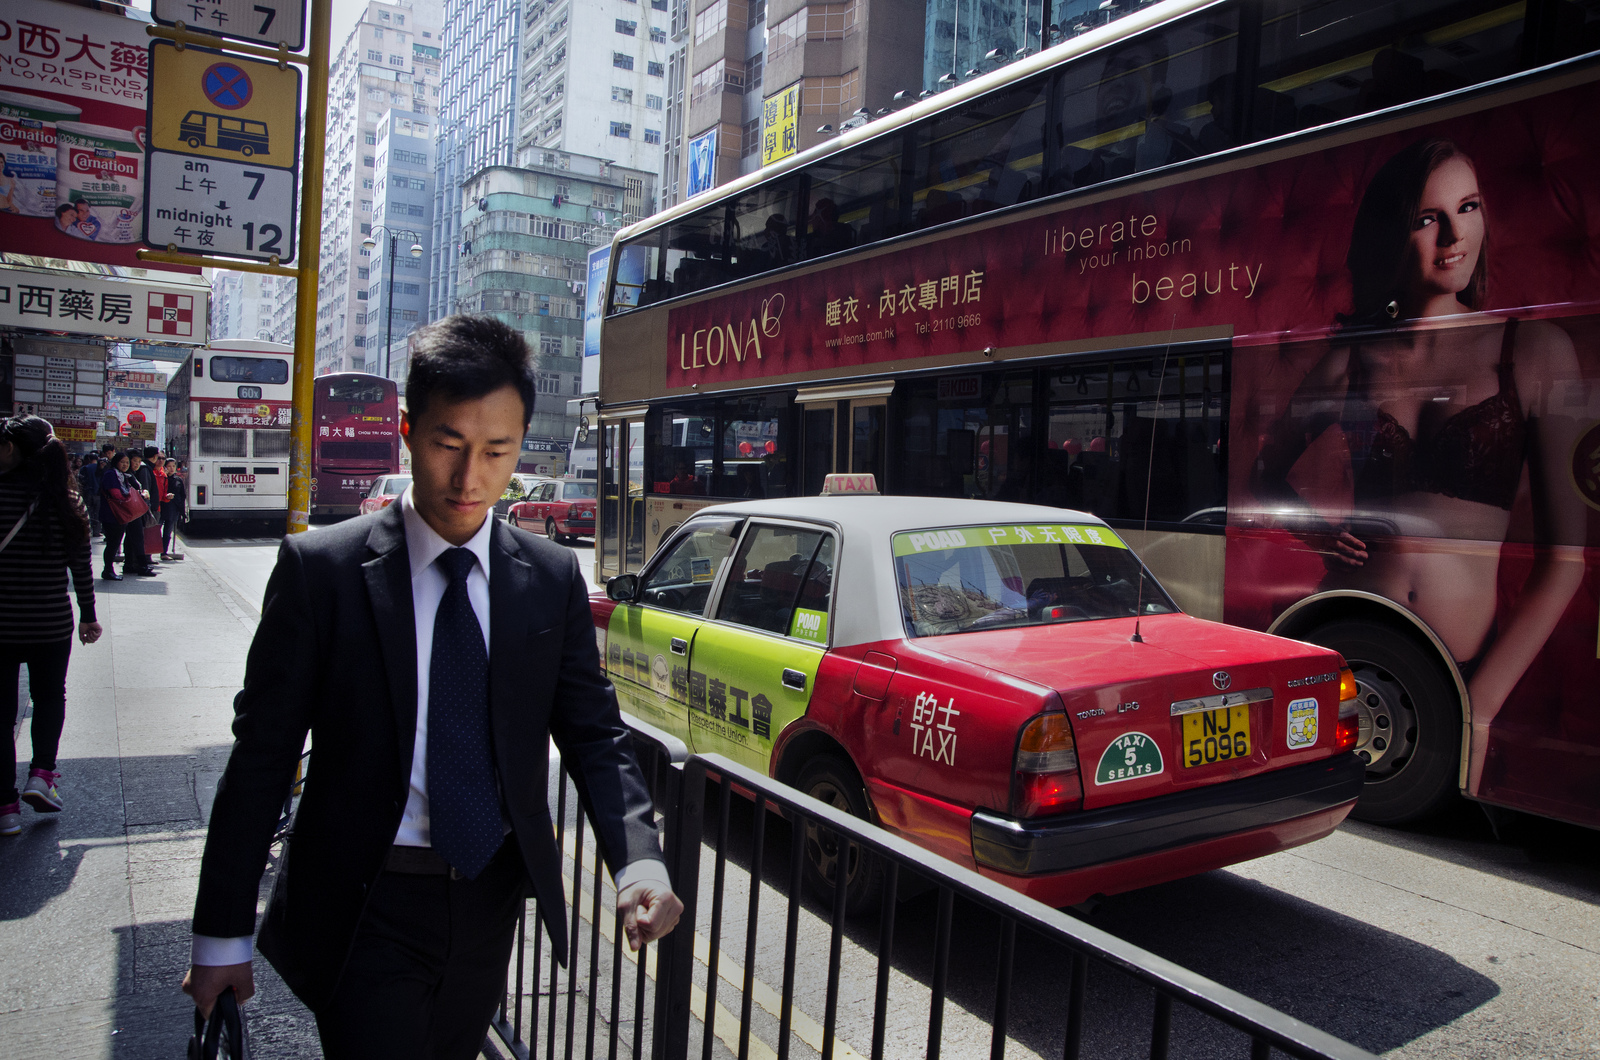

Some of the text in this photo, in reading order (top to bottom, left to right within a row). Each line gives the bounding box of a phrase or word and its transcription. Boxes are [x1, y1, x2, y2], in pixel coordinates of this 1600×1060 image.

[187, 4, 229, 27] 下午
[253, 5, 276, 35] 7
[11, 67, 143, 101] LOYAL SILVER
[42, 63, 148, 92] DISPENS
[72, 152, 135, 174] Carnation
[184, 160, 209, 173] am
[175, 175, 217, 195] 上午
[243, 170, 265, 200] 7
[156, 208, 232, 228] midnight
[173, 226, 215, 247] 午夜
[242, 222, 283, 255] 12
[1044, 214, 1158, 256] liberate
[1080, 238, 1191, 275] your inborn
[1131, 262, 1263, 304] beauty
[825, 312, 982, 348] www.leona.com.hk Tel: 2110 9666
[680, 318, 762, 371] LEONA
[950, 378, 979, 397] KMB
[231, 474, 256, 484] KMB
[834, 477, 874, 491] TAXI
[908, 530, 967, 552] POAD
[797, 612, 821, 632] POAD
[1304, 671, 1338, 686] COMFORT
[912, 690, 961, 733] 的士
[1076, 708, 1106, 720] TOYOTA
[1117, 701, 1140, 714] LPG
[690, 711, 749, 746] Respect the Union.
[1202, 706, 1231, 737] NJ
[910, 722, 958, 767] TAXI
[1115, 735, 1147, 751] TAXI
[1188, 730, 1248, 767] 5096
[1124, 747, 1137, 766] 5
[1108, 762, 1152, 780] SEATS
